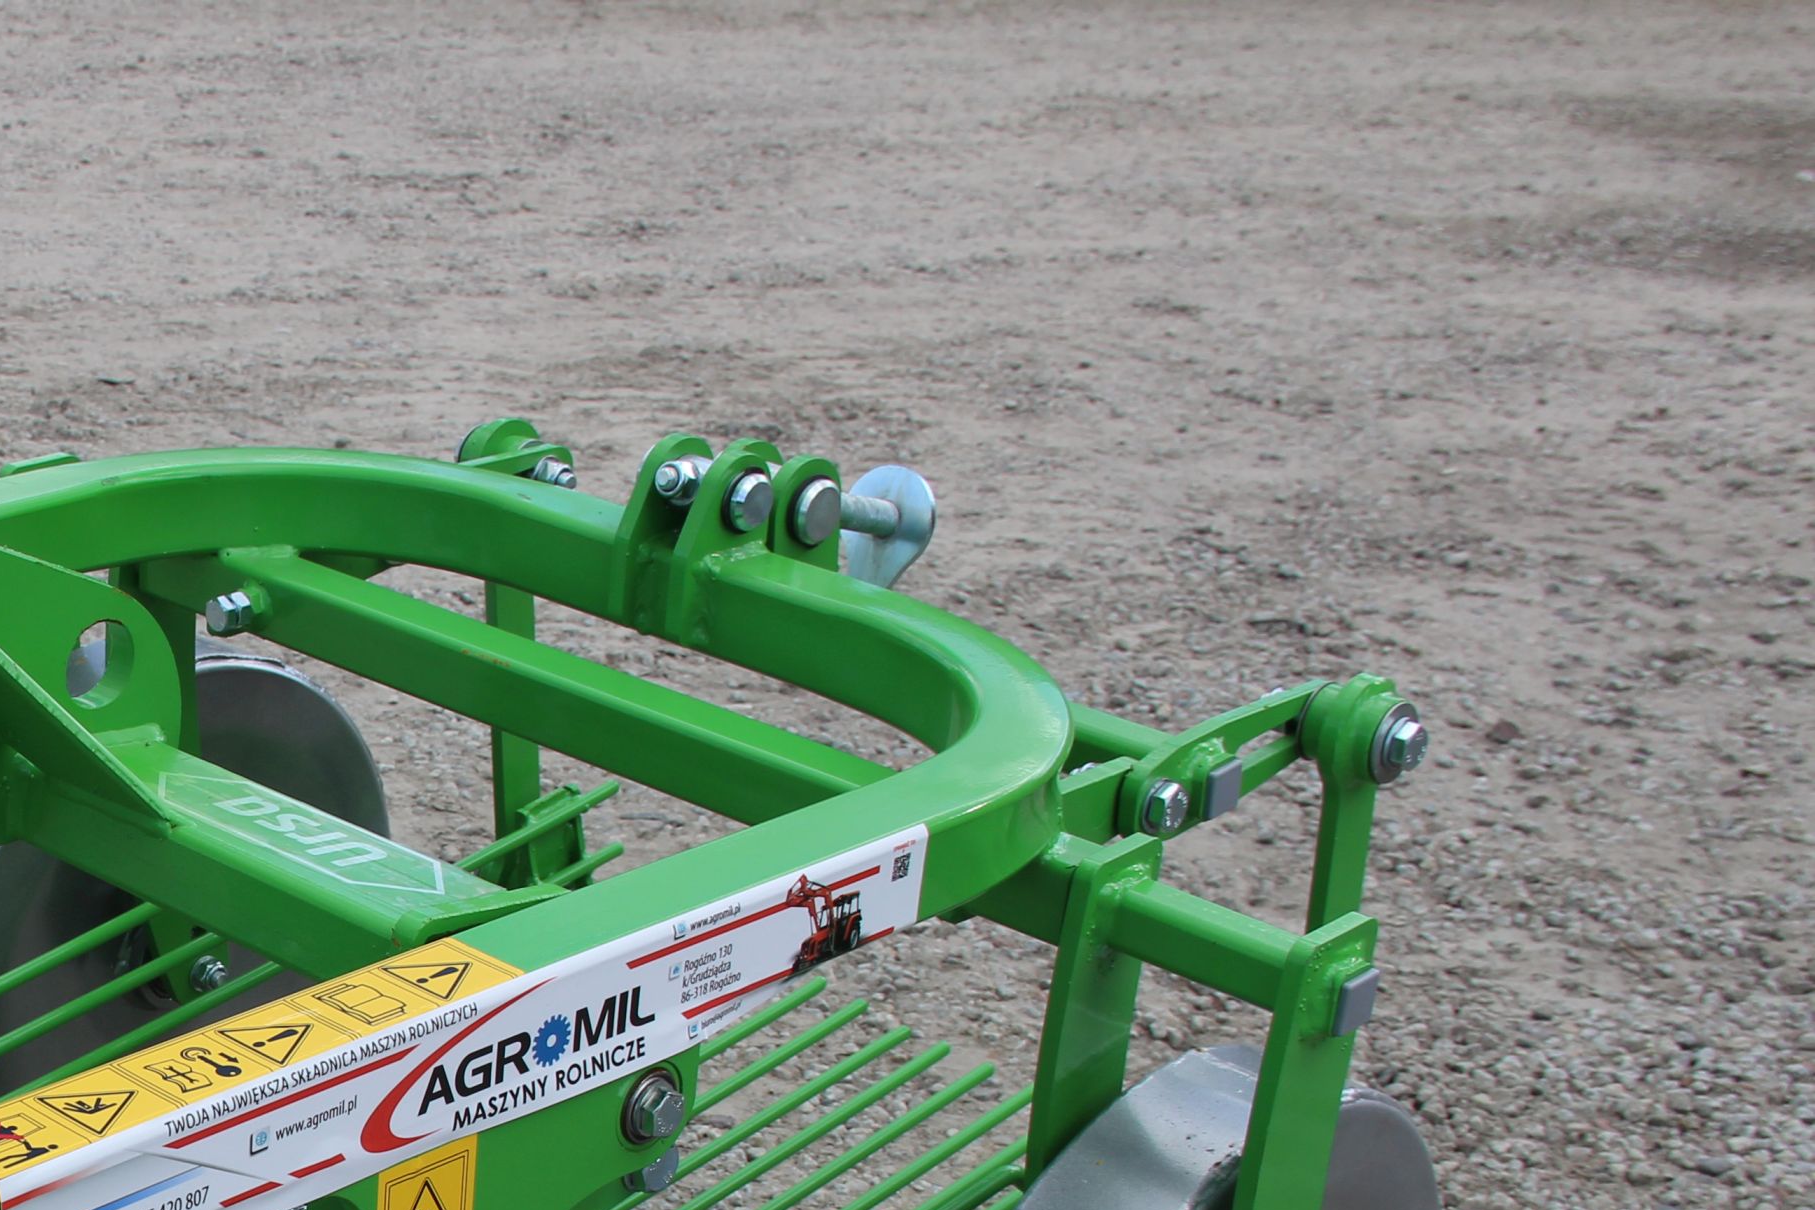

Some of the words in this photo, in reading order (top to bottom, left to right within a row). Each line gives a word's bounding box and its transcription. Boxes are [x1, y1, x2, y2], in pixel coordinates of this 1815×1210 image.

[690, 902, 742, 931] www.agromil.pl
[683, 951, 717, 973] Rogóźno
[718, 943, 733, 958] 130
[680, 983, 708, 1004] 86-318
[709, 972, 742, 994] Rogóźno
[682, 961, 732, 988] k/Grudziądza
[417, 985, 656, 1116] AGROMIL
[164, 1112, 210, 1137] TWOJA
[212, 1076, 289, 1117] NAJWIĘKSZA
[291, 1050, 358, 1088] SKŁADNICA
[360, 1027, 407, 1060] MASZYN
[409, 1002, 479, 1044] ROLNICZYCH
[452, 1075, 548, 1131] MASZYNY
[555, 1036, 646, 1091] ROLNICZE
[275, 1096, 358, 1141] www.agromil.pl
[185, 1185, 210, 1210] 807
